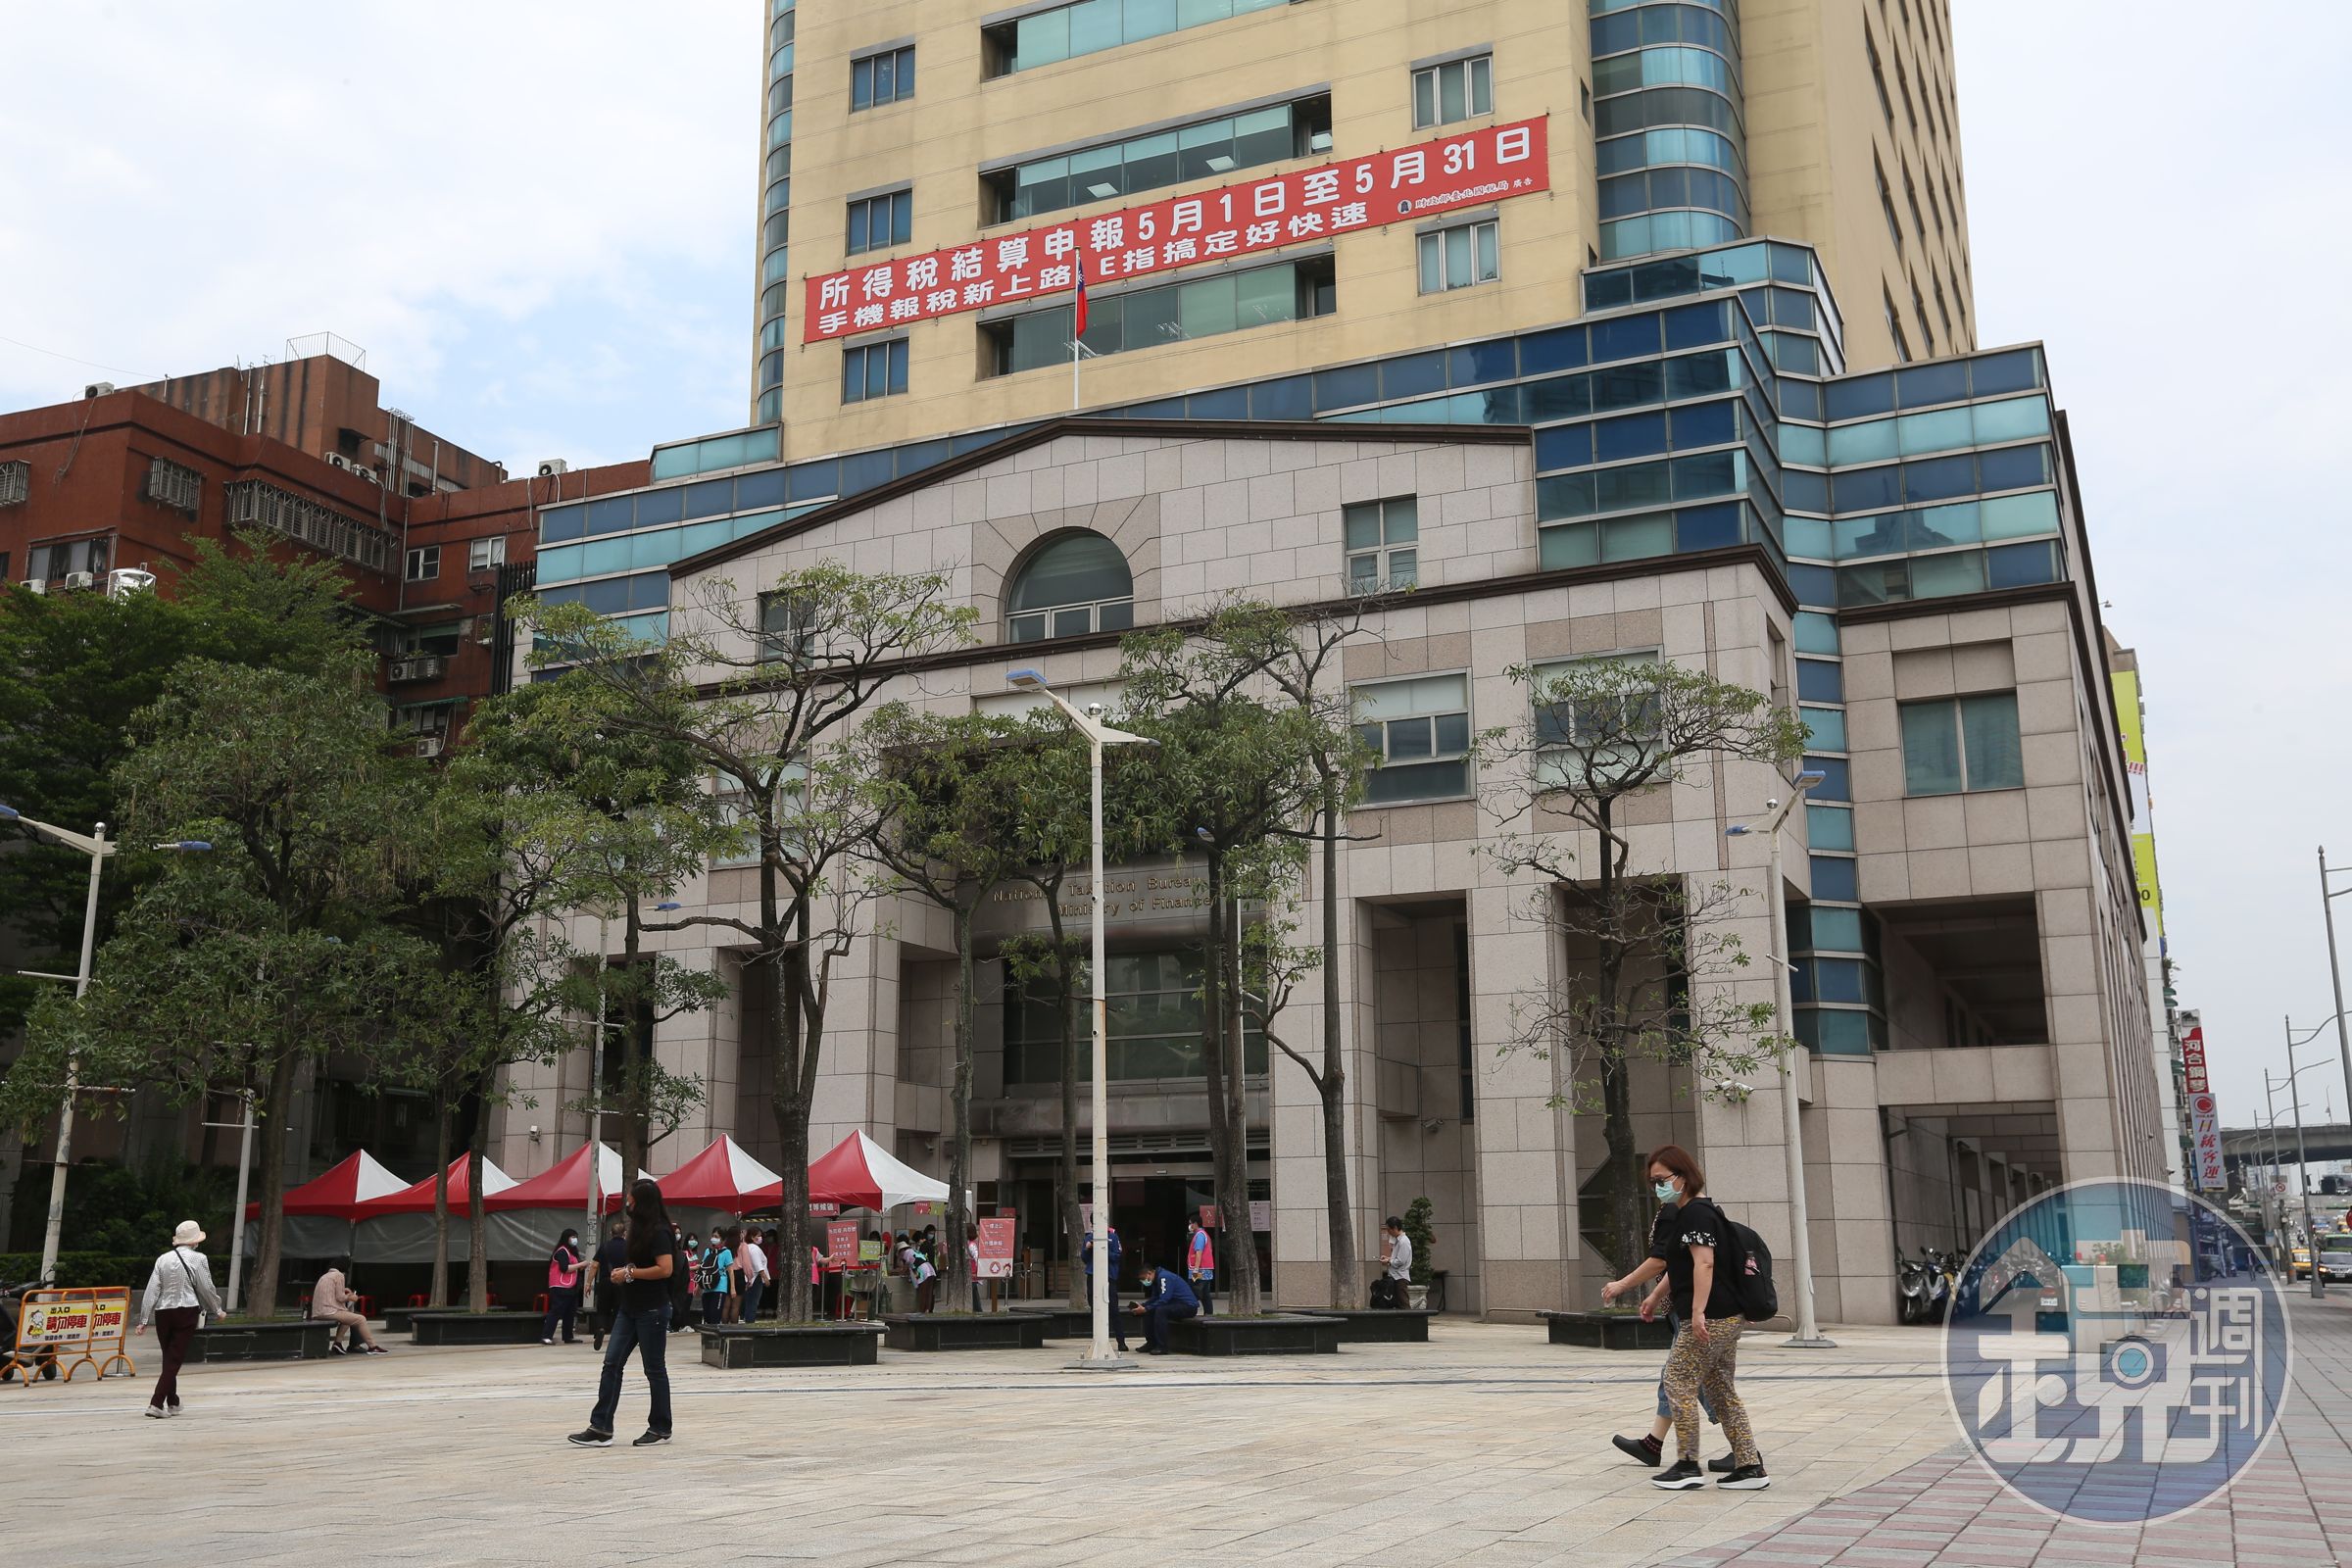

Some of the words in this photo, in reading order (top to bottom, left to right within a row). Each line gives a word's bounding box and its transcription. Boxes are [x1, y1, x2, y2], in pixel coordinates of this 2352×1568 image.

[819, 126, 1530, 311] 所得稅結算申報5月1日至5月31日
[818, 264, 1071, 335] 手機報稅新上路
[1100, 201, 1368, 276] E指搞定好快速
[994, 887, 1048, 902] Nation
[1068, 879, 1136, 897] Taxtion
[1058, 901, 1119, 917] Minisry
[1129, 899, 1145, 912] of
[46, 1315, 87, 1333] 請勿停車
[93, 1312, 122, 1329] 勿停車
